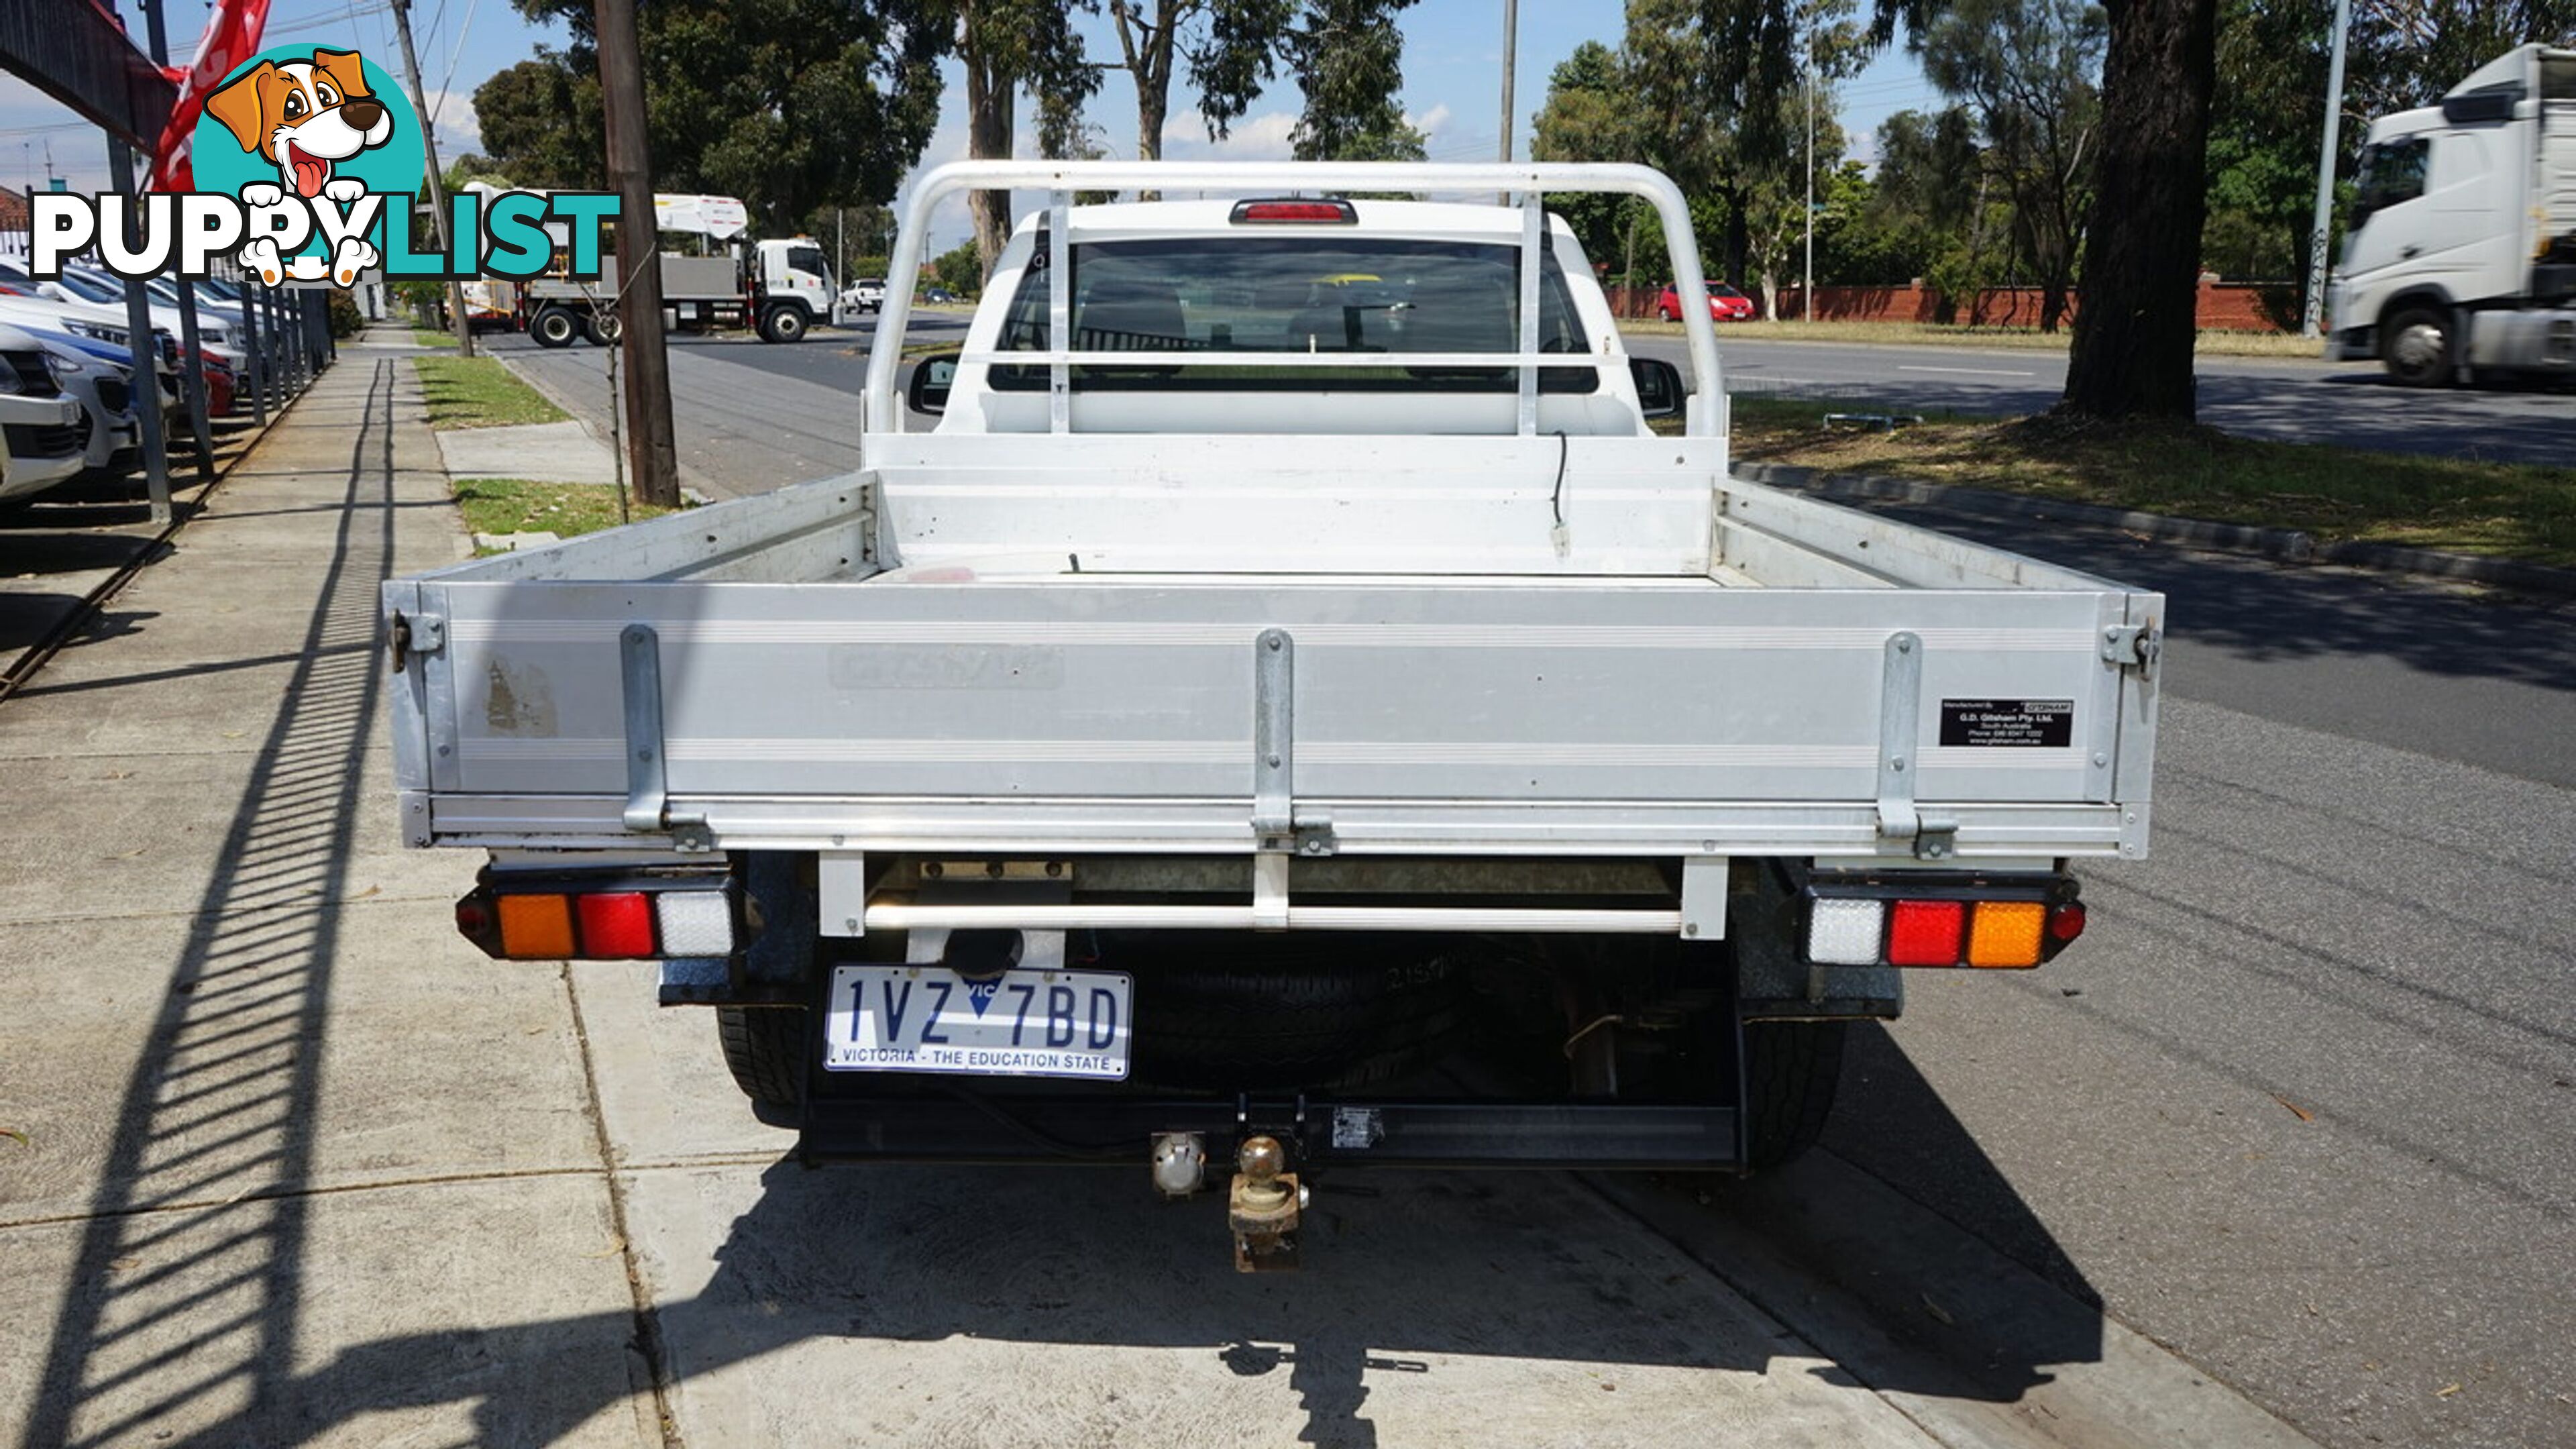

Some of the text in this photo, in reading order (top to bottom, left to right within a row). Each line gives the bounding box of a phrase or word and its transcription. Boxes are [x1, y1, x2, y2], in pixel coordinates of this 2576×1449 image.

[1960, 713, 1978, 722] G.D.
[849, 979, 1117, 1051] 1VZ 7BD
[843, 1048, 915, 1063] VICTORIA
[932, 1051, 963, 1064] THE
[969, 1052, 1059, 1067] EDUCATION
[1064, 1057, 1110, 1070] STATE
